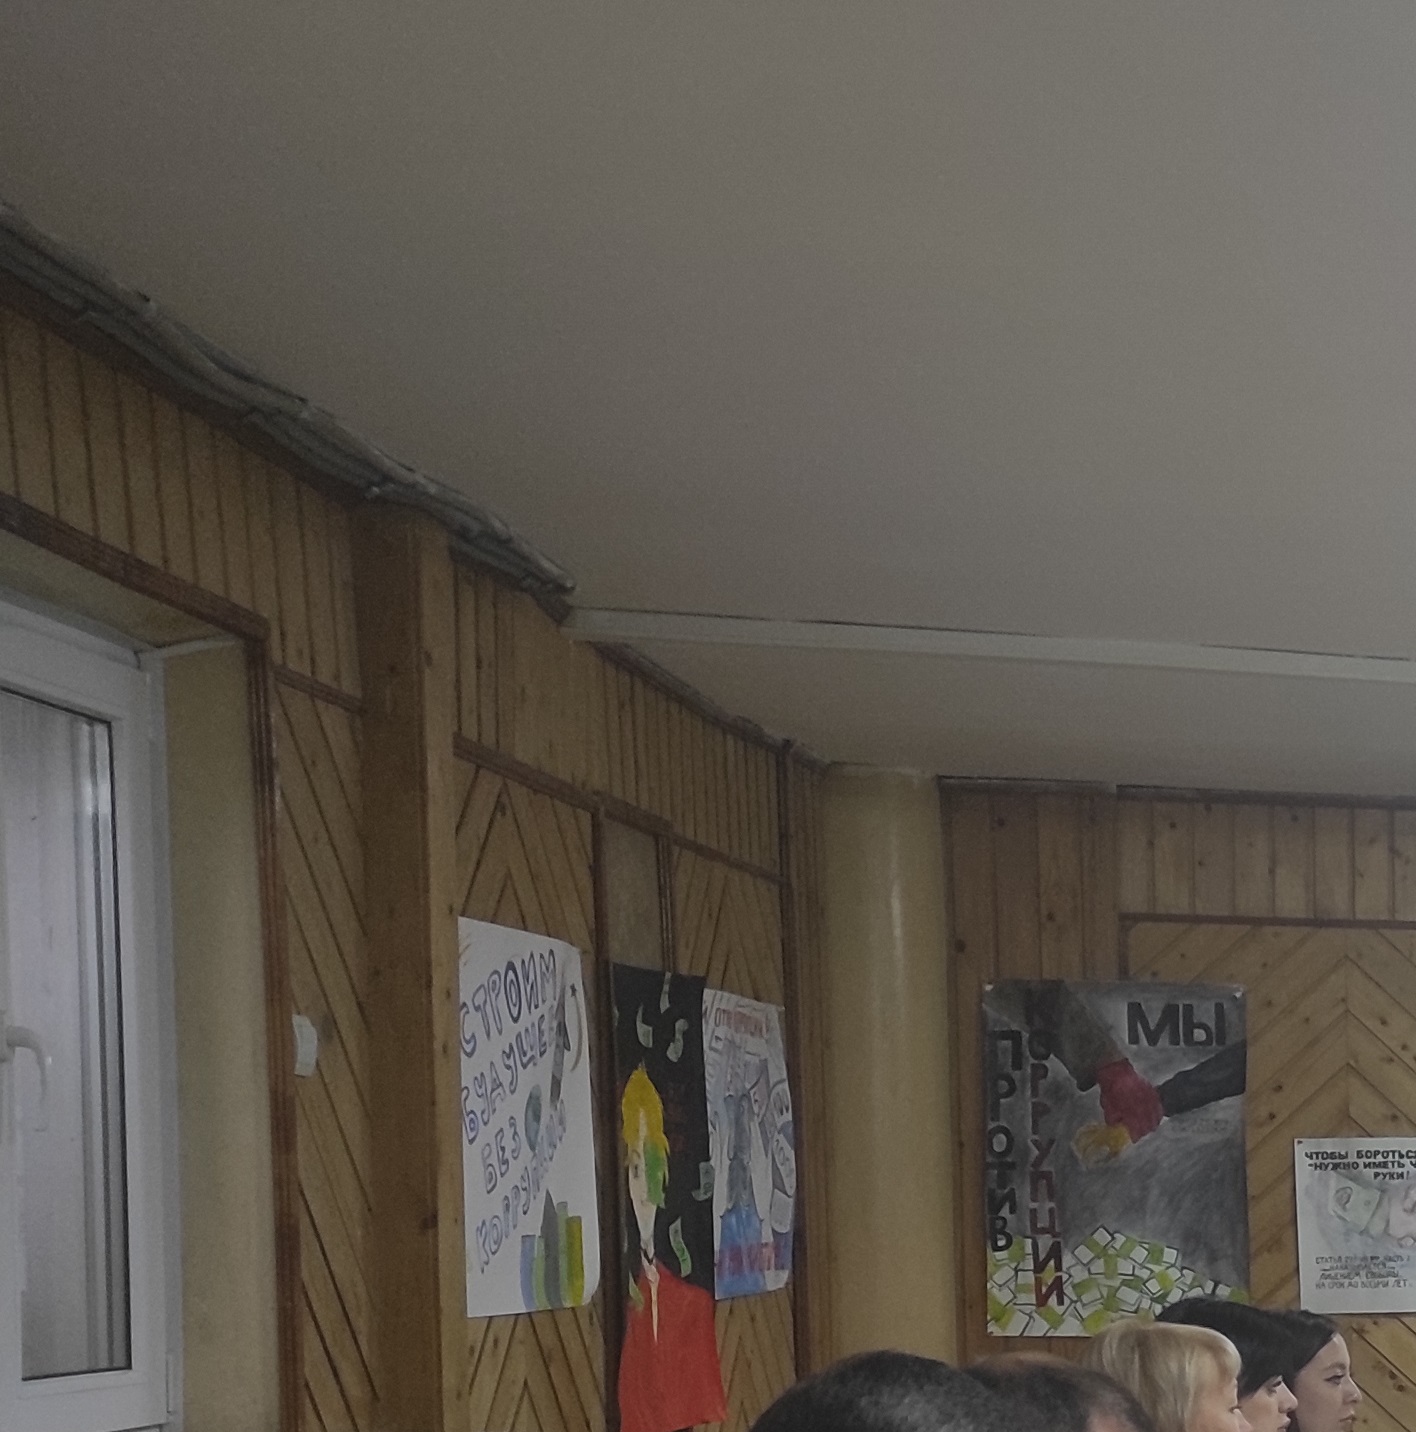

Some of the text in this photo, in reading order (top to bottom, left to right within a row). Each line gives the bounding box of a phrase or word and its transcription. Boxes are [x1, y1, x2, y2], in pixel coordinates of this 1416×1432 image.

[460, 948, 558, 1058] СТРОИМ
[1126, 1001, 1227, 1047] МЫ
[481, 1114, 522, 1195] БЕЗ
[1304, 1150, 1349, 1161] ЧТОБЫ
[1362, 1160, 1406, 1170] ИМЕТЬ
[1373, 1170, 1411, 1181] РУКИ!
